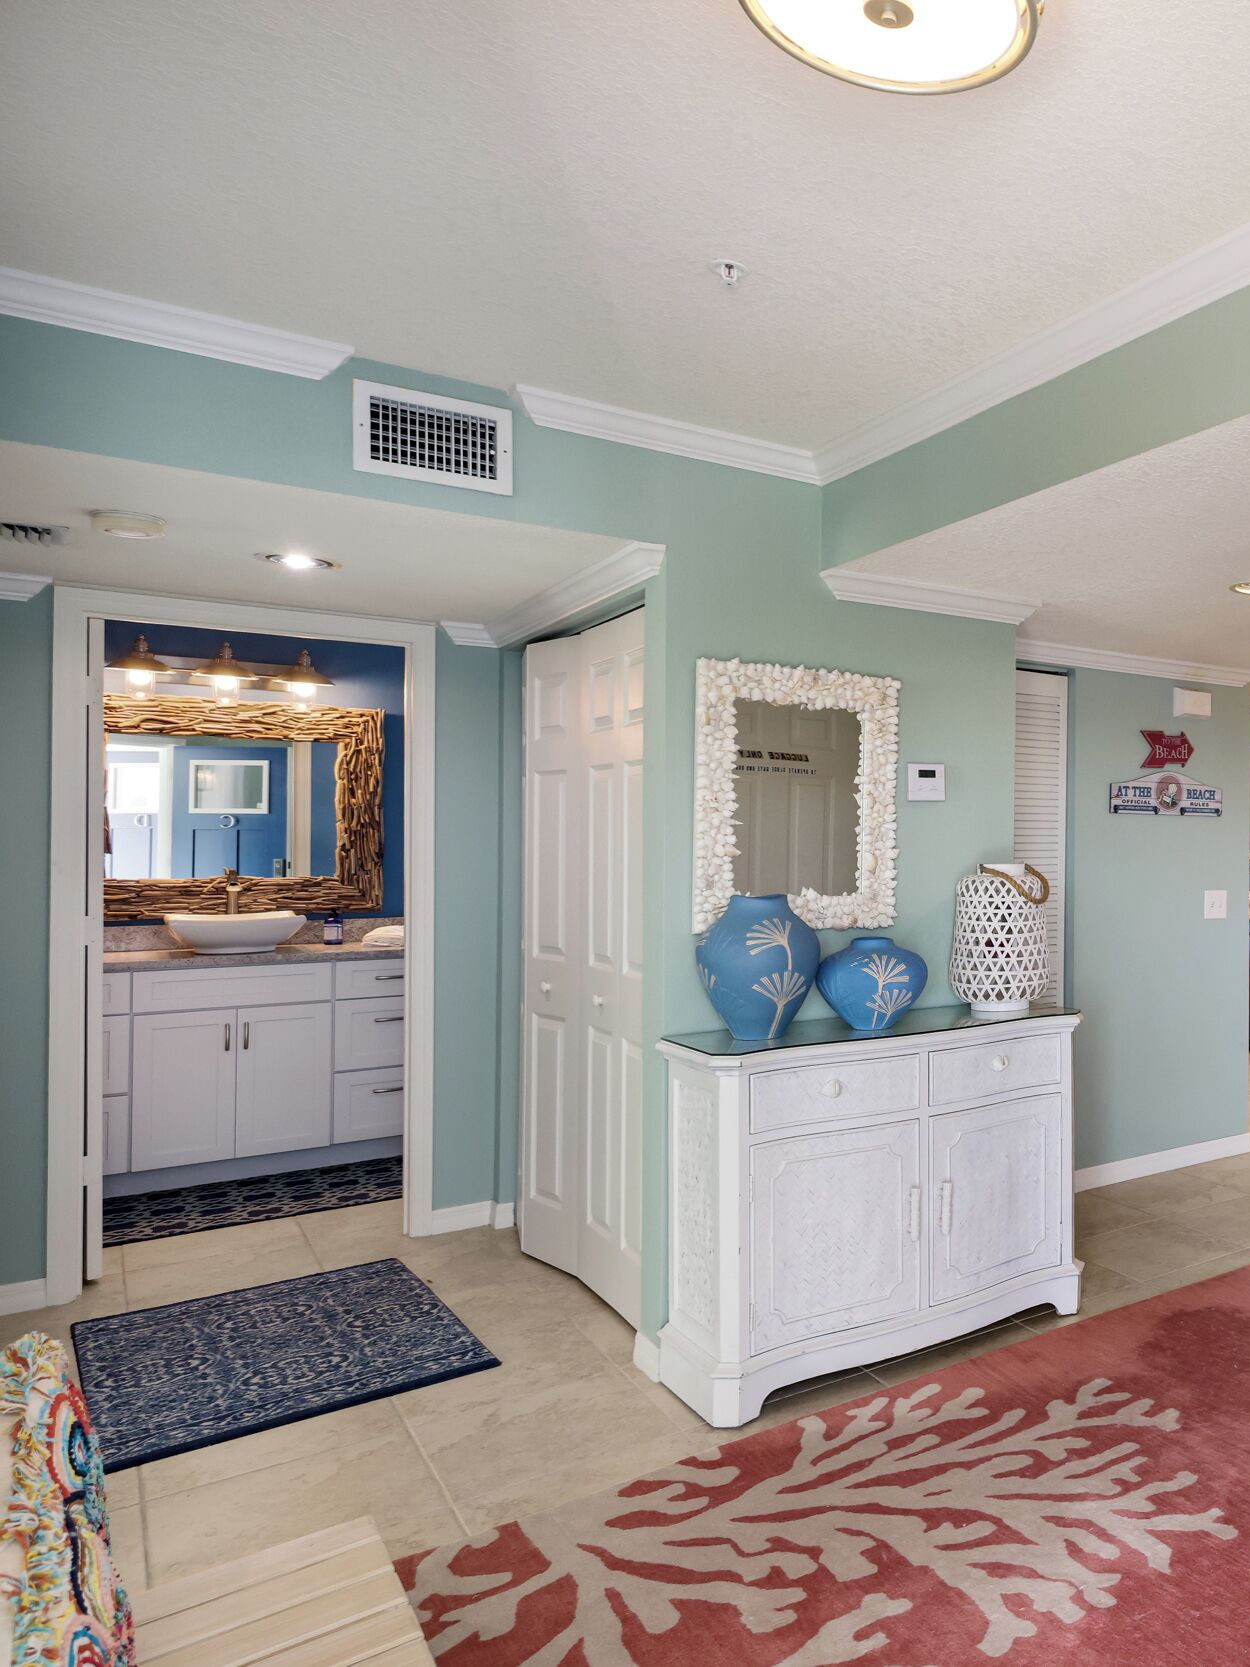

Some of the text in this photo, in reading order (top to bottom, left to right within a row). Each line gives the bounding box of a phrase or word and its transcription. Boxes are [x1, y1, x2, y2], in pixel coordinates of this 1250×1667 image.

[1155, 743, 1188, 759] BEACH
[1116, 786, 1216, 801] AT THE BEACH
